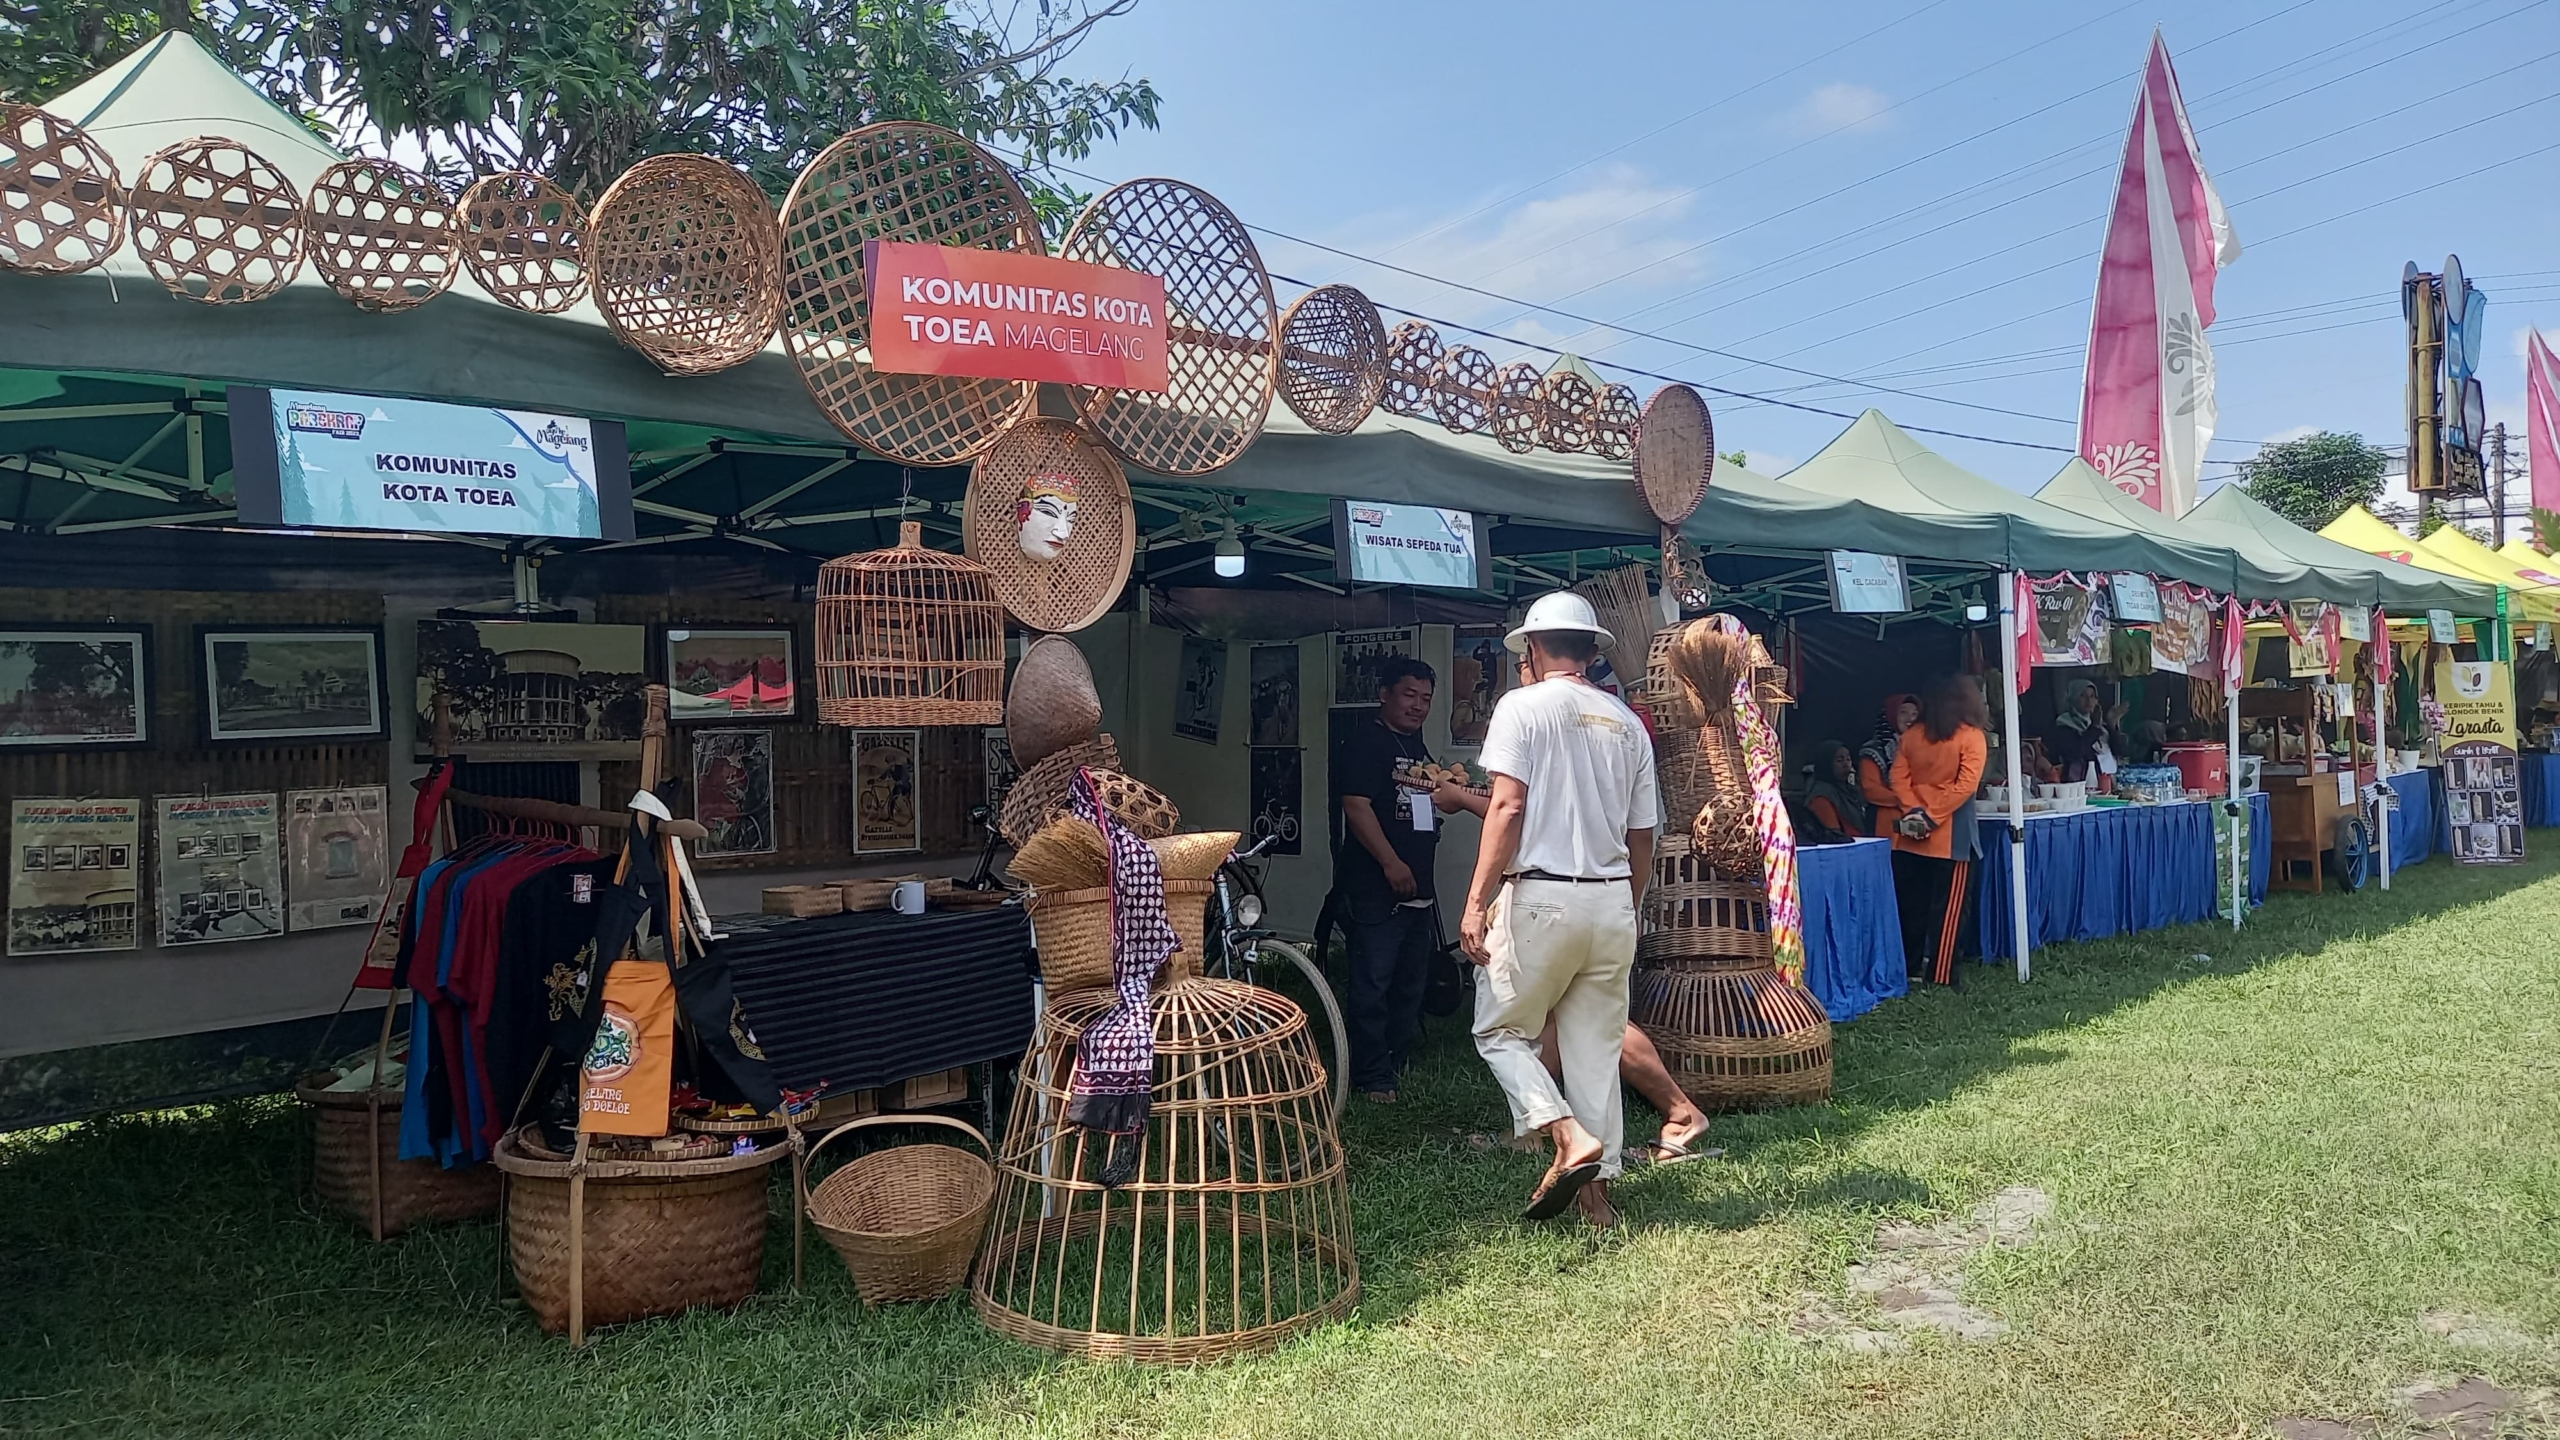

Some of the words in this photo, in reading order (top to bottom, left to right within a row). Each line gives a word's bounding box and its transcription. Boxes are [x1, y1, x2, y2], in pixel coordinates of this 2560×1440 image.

[901, 275, 1088, 319] KOMUNITAS
[1093, 295, 1154, 329] KOTA
[902, 314, 996, 347] TOEA
[1004, 322, 1145, 361] MAGELANG
[536, 429, 588, 452] Magelang
[375, 453, 518, 479] KOMUNITAS
[382, 483, 450, 503] KOTA
[454, 487, 517, 507] TOEA
[1365, 534, 1404, 548] WISATA
[1406, 538, 1442, 552] SEPEDA
[1444, 542, 1462, 555] TUA
[1344, 632, 1402, 643] FONGERS
[2442, 716, 2505, 738] Larasta
[592, 1100, 631, 1114] DOELOE
